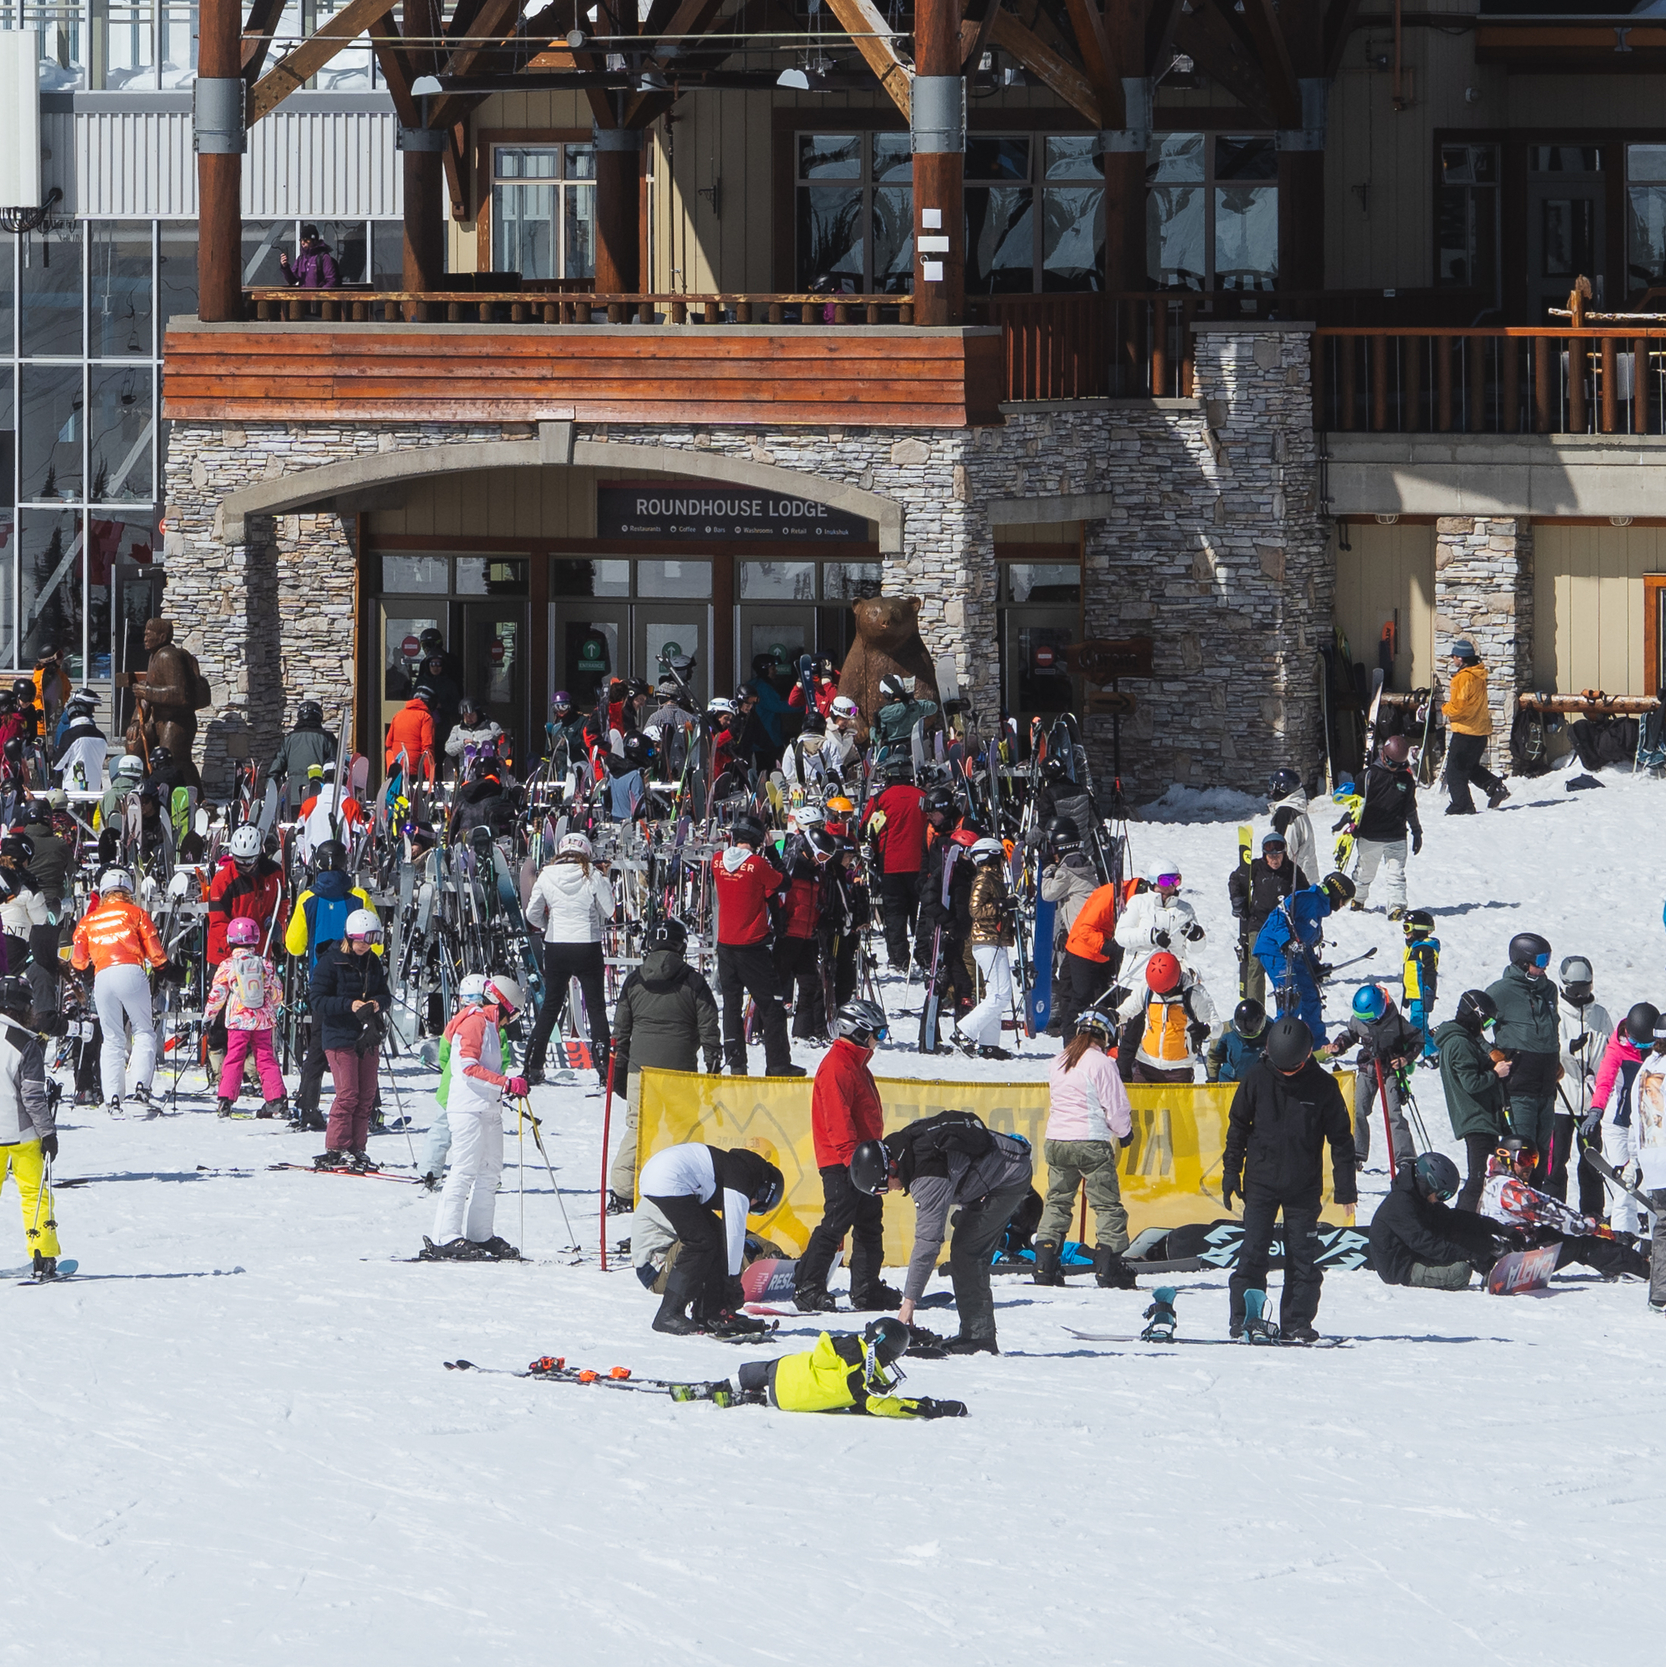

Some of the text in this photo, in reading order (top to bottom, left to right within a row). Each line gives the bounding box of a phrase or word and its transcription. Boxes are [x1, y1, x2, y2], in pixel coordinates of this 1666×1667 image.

[636, 498, 828, 517] ROUNDHOUSE LODGE
[629, 525, 661, 533] Restaurants
[678, 525, 697, 533] Coffee
